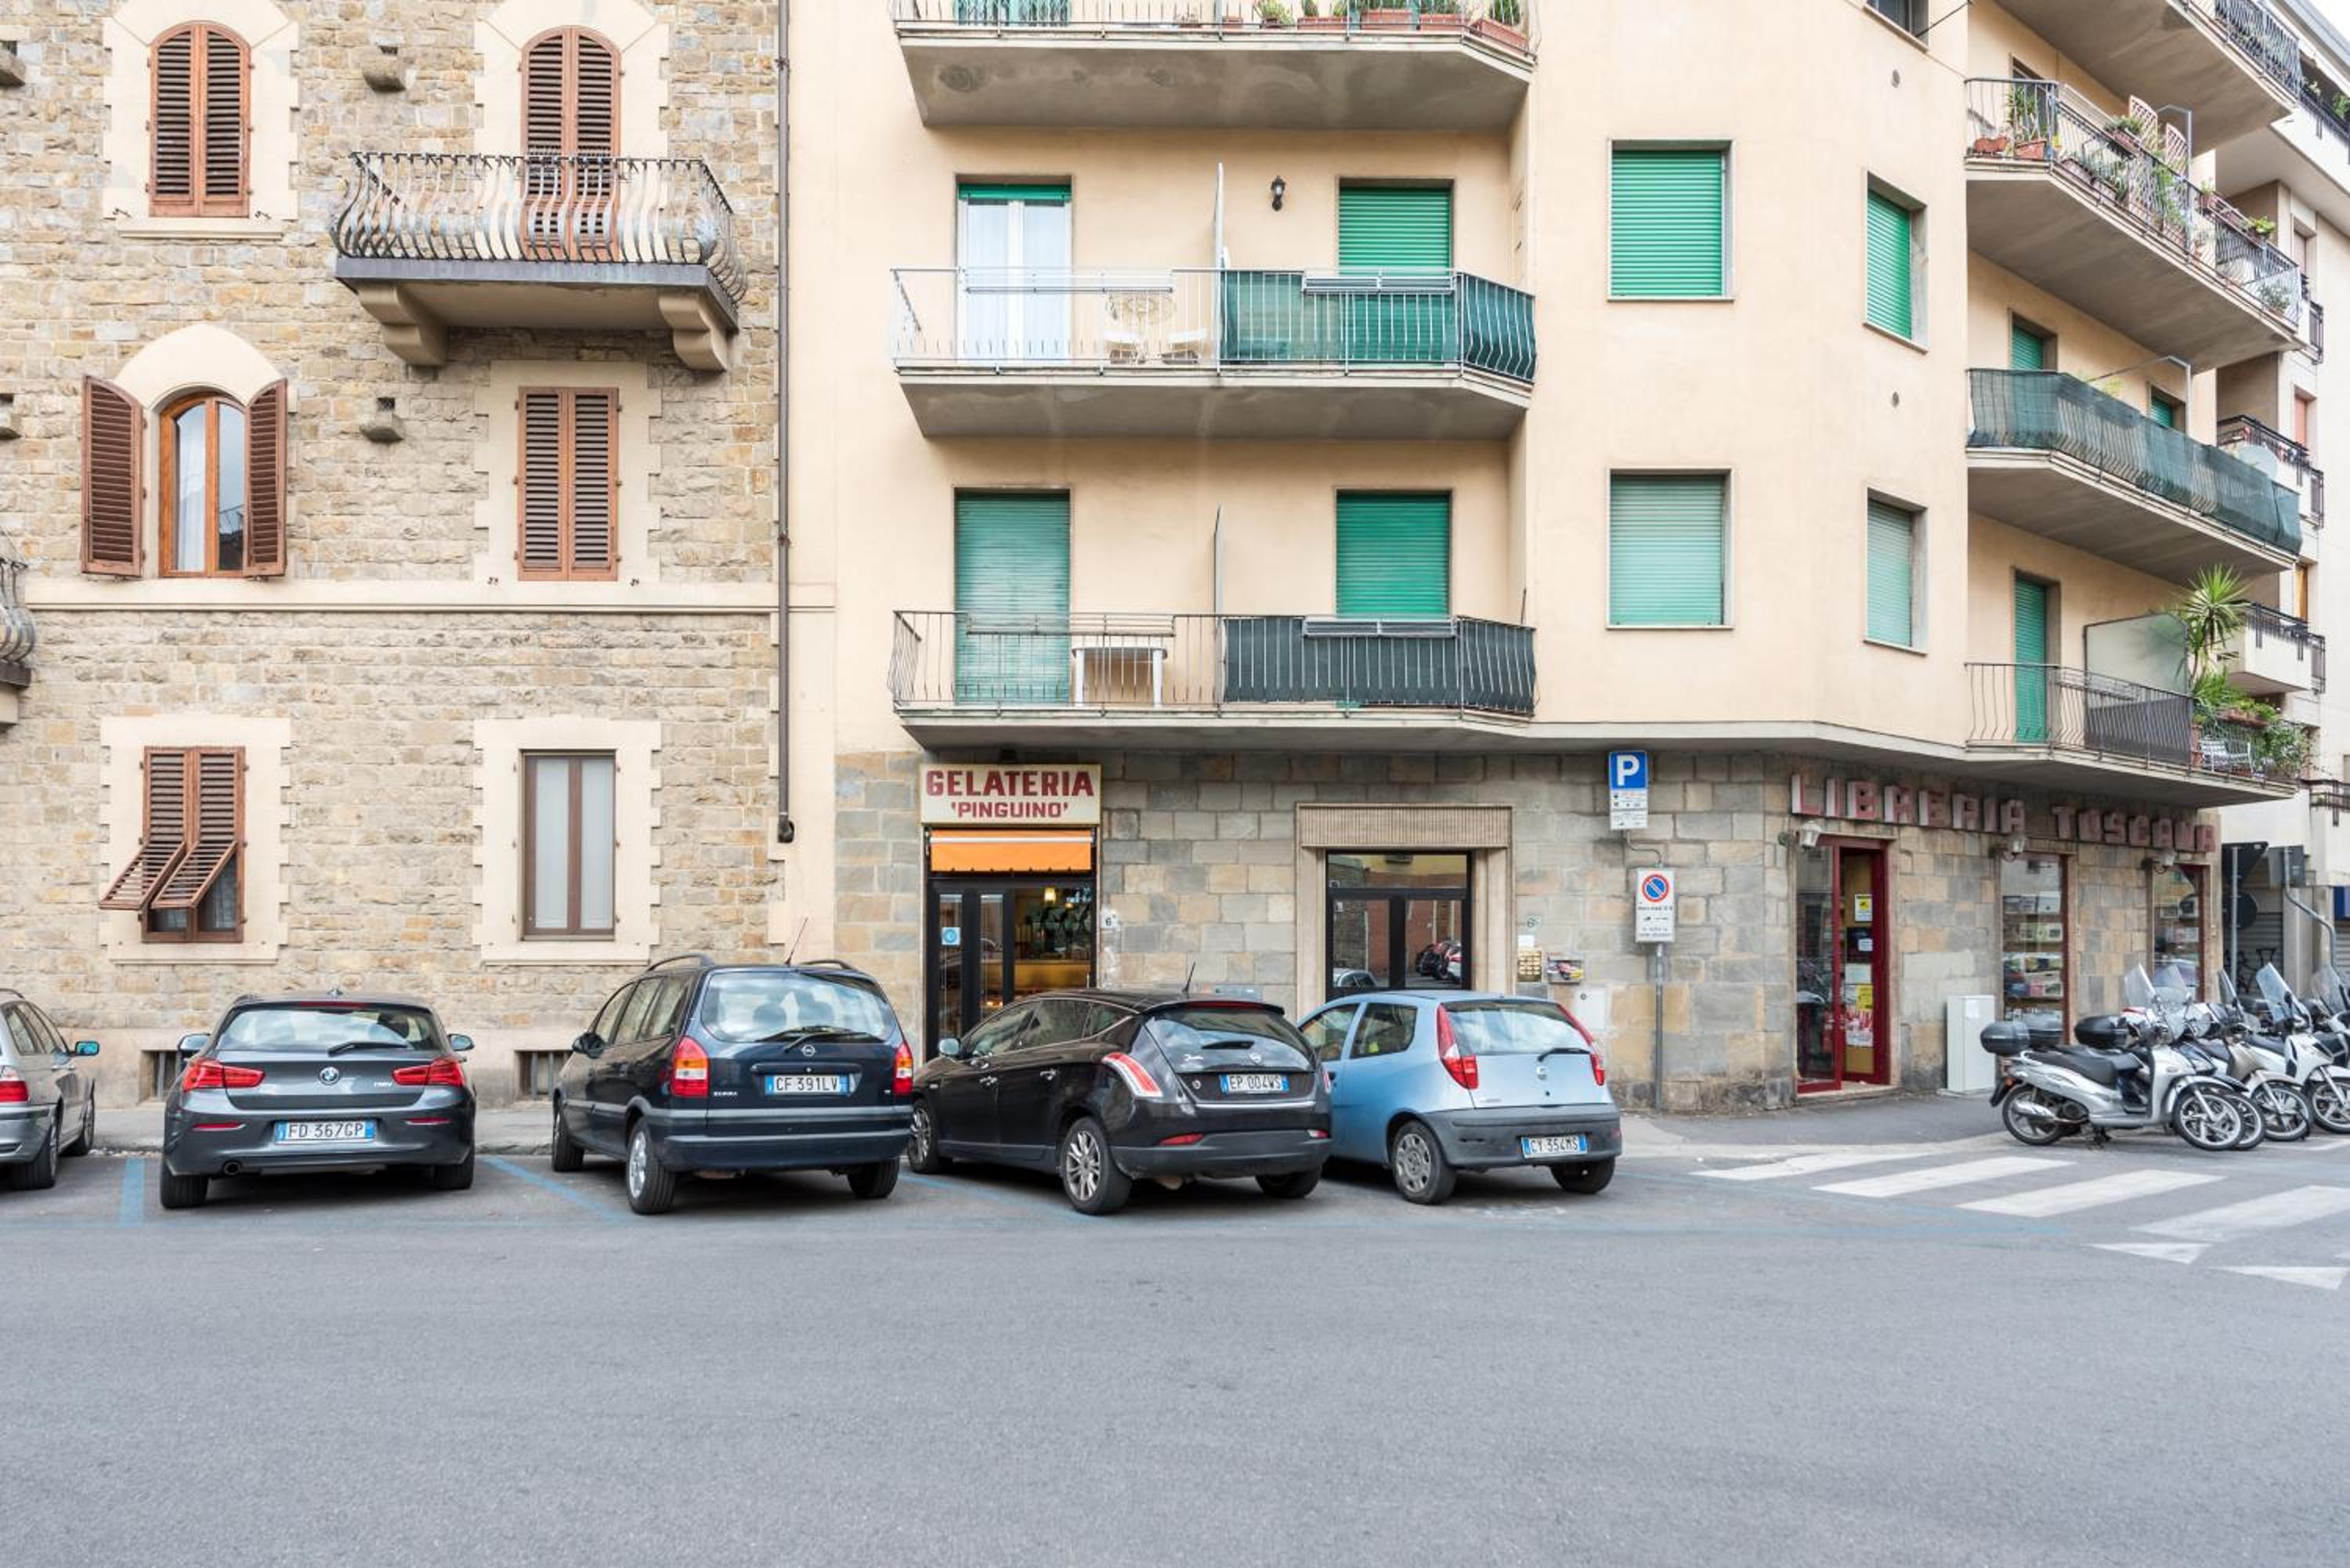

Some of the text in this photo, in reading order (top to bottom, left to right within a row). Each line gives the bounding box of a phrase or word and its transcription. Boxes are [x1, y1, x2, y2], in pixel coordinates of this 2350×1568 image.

[926, 770, 1094, 797] GELATERIA
[1617, 754, 1640, 786] P
[1791, 775, 2025, 833] LIBRERIA
[2052, 805, 2216, 853] TOSCANA
[776, 1076, 838, 1091] CF 391LV
[1229, 1075, 1242, 1089] EP
[289, 1122, 364, 1138] FD 367GP
